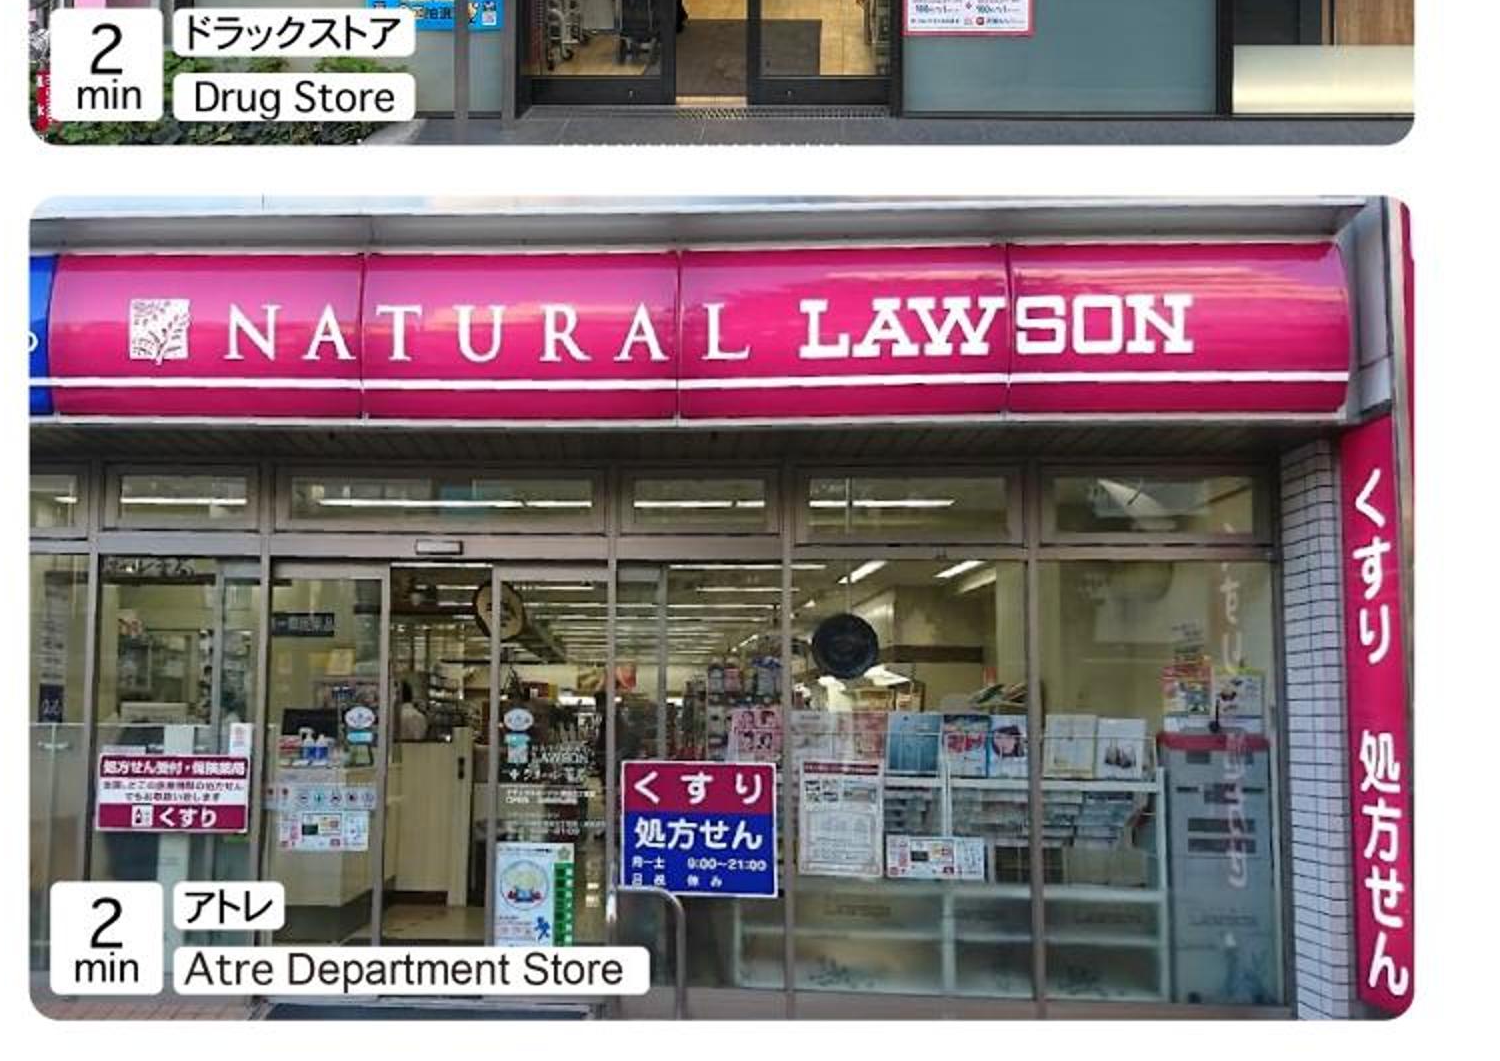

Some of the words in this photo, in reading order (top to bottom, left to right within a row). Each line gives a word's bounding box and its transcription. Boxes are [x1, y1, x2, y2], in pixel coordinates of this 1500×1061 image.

[226, 301, 750, 363] NATURAL
[798, 293, 1195, 359] LAWSON
[1354, 469, 1391, 664] くすり
[633, 771, 763, 805] くすり
[159, 807, 218, 828] くすり
[633, 817, 763, 850] 処方せん
[1360, 731, 1409, 998] 処方せん
